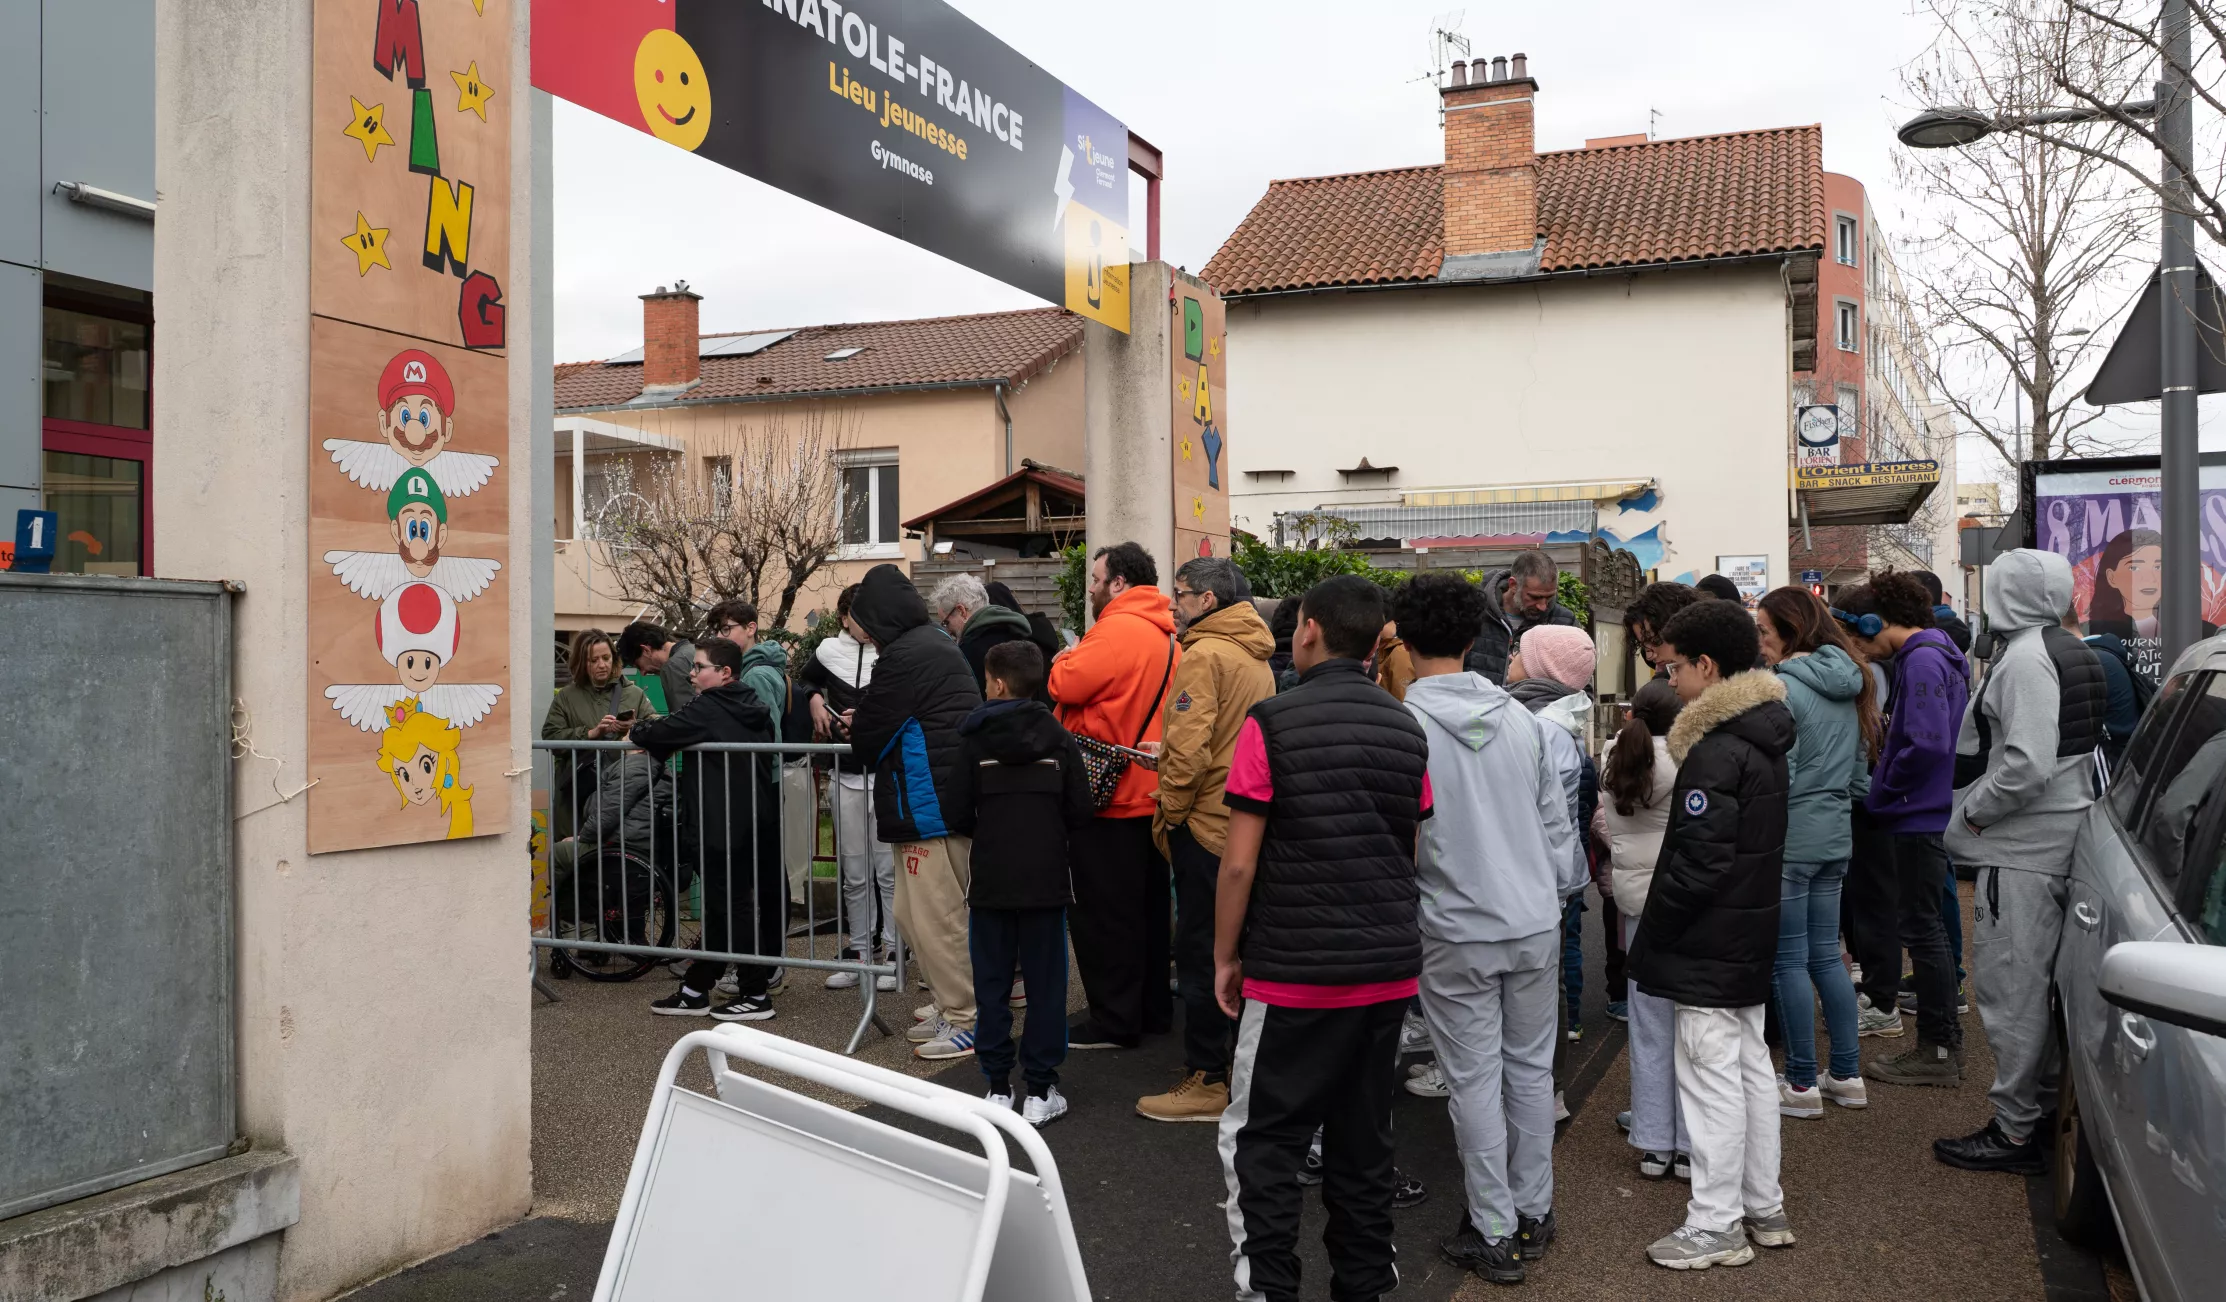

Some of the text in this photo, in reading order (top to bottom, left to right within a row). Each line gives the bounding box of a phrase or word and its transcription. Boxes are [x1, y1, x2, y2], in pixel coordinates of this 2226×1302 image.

[829, 61, 968, 160] Lieu jeunesse
[871, 140, 934, 186] Gymnase
[1800, 456, 1837, 465] L'ORIENT
[1807, 447, 1831, 458] BAR
[1801, 461, 1936, 478] L'Orient Express
[1799, 478, 1819, 489] BAR
[1828, 478, 1861, 487] SNACK
[1871, 473, 1937, 485] RESTAURANT
[27, 516, 44, 549] 1
[906, 856, 919, 876] 47
